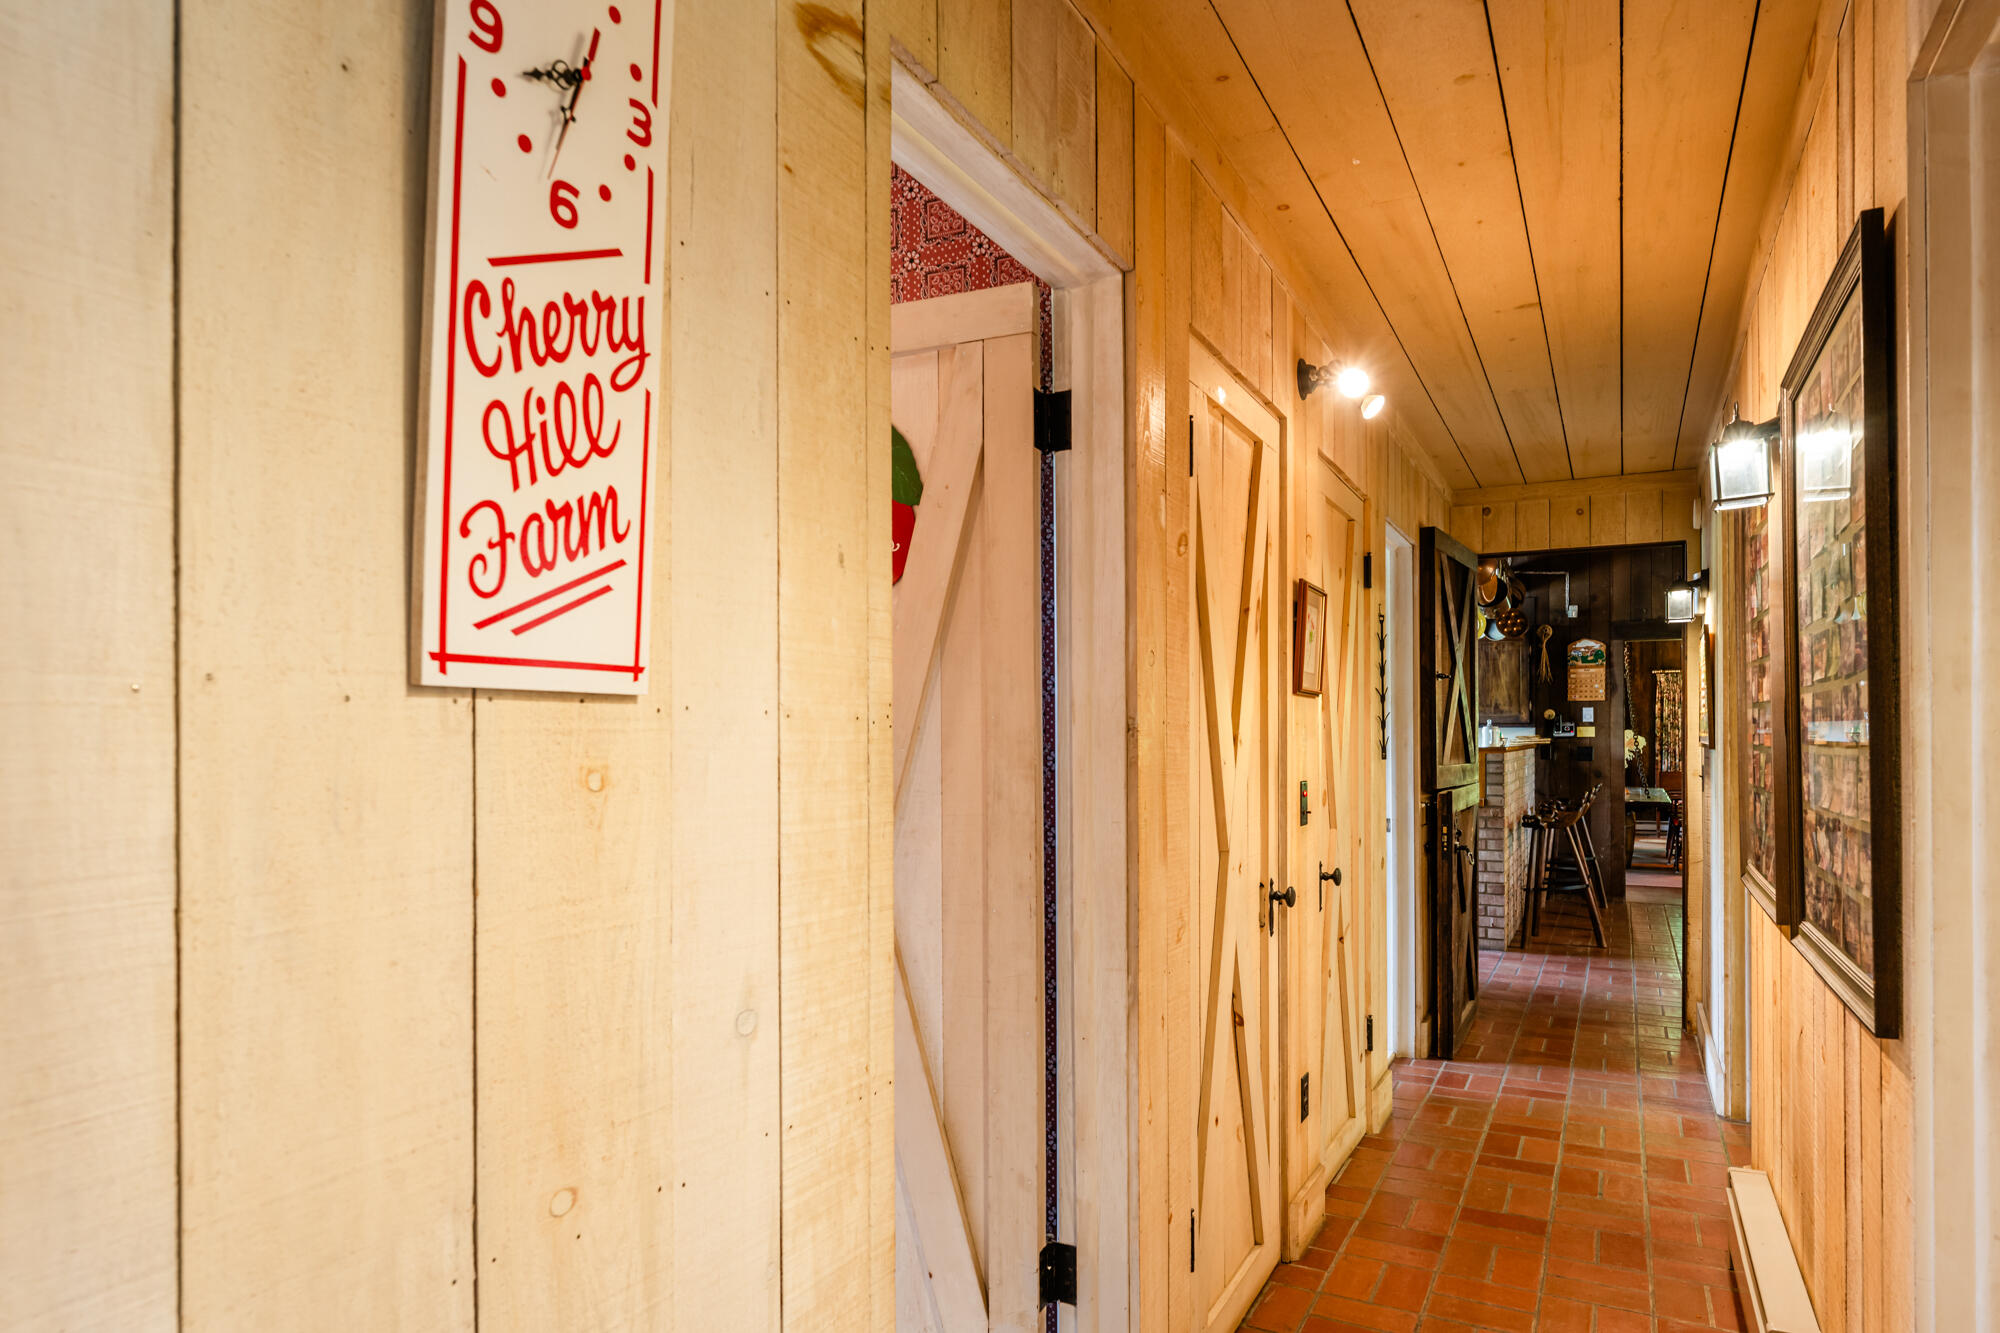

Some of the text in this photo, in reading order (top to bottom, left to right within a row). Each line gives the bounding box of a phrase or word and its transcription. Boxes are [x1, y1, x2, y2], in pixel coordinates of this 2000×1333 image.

[469, 0, 504, 54] 9
[626, 97, 653, 148] 3
[549, 180, 580, 230] 6
[463, 277, 652, 392] Cherry
[482, 372, 622, 493] Hill
[459, 485, 631, 599] Farm
